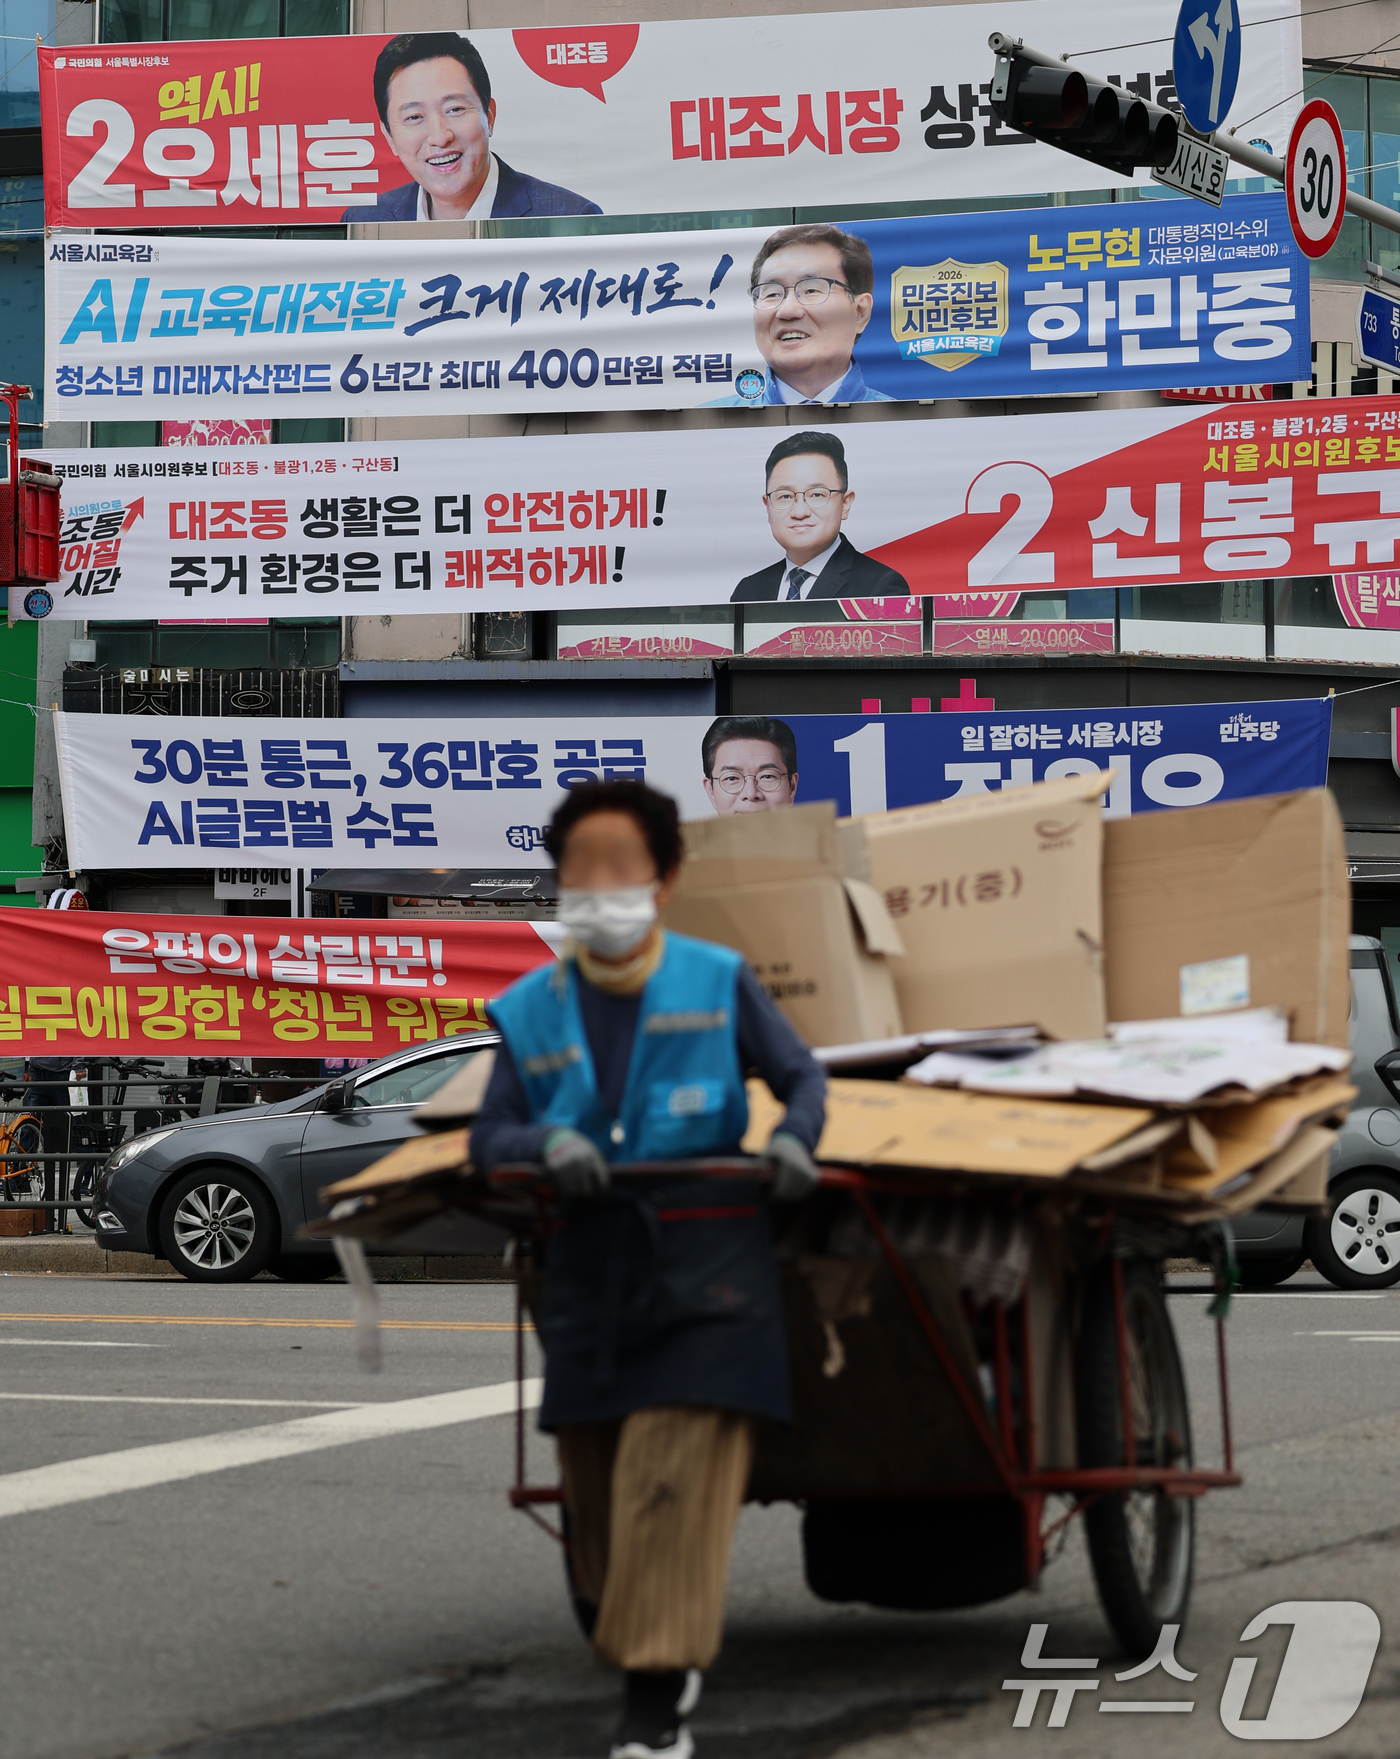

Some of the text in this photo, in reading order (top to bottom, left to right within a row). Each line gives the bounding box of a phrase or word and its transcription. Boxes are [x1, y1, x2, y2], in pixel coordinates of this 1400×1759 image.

[69, 56, 170, 68] 국민의힘 서울특별시장후보
[546, 41, 608, 65] 대조동
[158, 62, 261, 125] 역시!
[670, 88, 903, 161] 대조시장
[141, 119, 378, 209] 오세훈
[1155, 144, 1224, 199] 시신호
[1300, 147, 1334, 219] 30
[50, 244, 153, 263] 서울시교육감
[1027, 219, 1269, 272] 노무현 대통령직인수위
[59, 253, 734, 344] AI 교육대전환 크게 제대로!
[902, 281, 998, 307] 민주진보
[937, 270, 963, 281] 2026
[902, 306, 999, 333] 시민후보
[1024, 267, 1296, 370] 한만중
[1363, 311, 1378, 333] 733
[906, 336, 995, 356] 서울시교육감
[55, 347, 733, 398] 청소년 미래자산펀드 6년간 최대 400만원 적립
[1207, 410, 1400, 441] 대조동 불광1,2동 구산
[54, 456, 399, 478] 국민의힘 서울시의원후보 [대조동 불광1,2동 구산동]
[59, 510, 126, 545] 조동
[68, 499, 123, 518] 시의원으로
[168, 487, 667, 541] 대조동 생활은 더 안전하게!
[965, 461, 1400, 587] 2 신봉규
[63, 566, 122, 598] 시간
[168, 546, 625, 597] 주거 환경은 더 쾌적하게!
[975, 627, 1008, 650] 염색
[961, 720, 1281, 752] 일 잘하는 서울시장 민주당
[131, 738, 248, 786] 30분
[260, 738, 366, 797] 통근,
[377, 740, 542, 791] 36만호
[834, 722, 887, 818] 1
[138, 798, 333, 849] AI글로벌
[346, 799, 438, 848] 수도
[253, 887, 267, 897] 2F
[102, 927, 447, 987] 은평의 살림꾼!
[137, 984, 245, 1041] 강한
[386, 997, 498, 1042] 워킹
